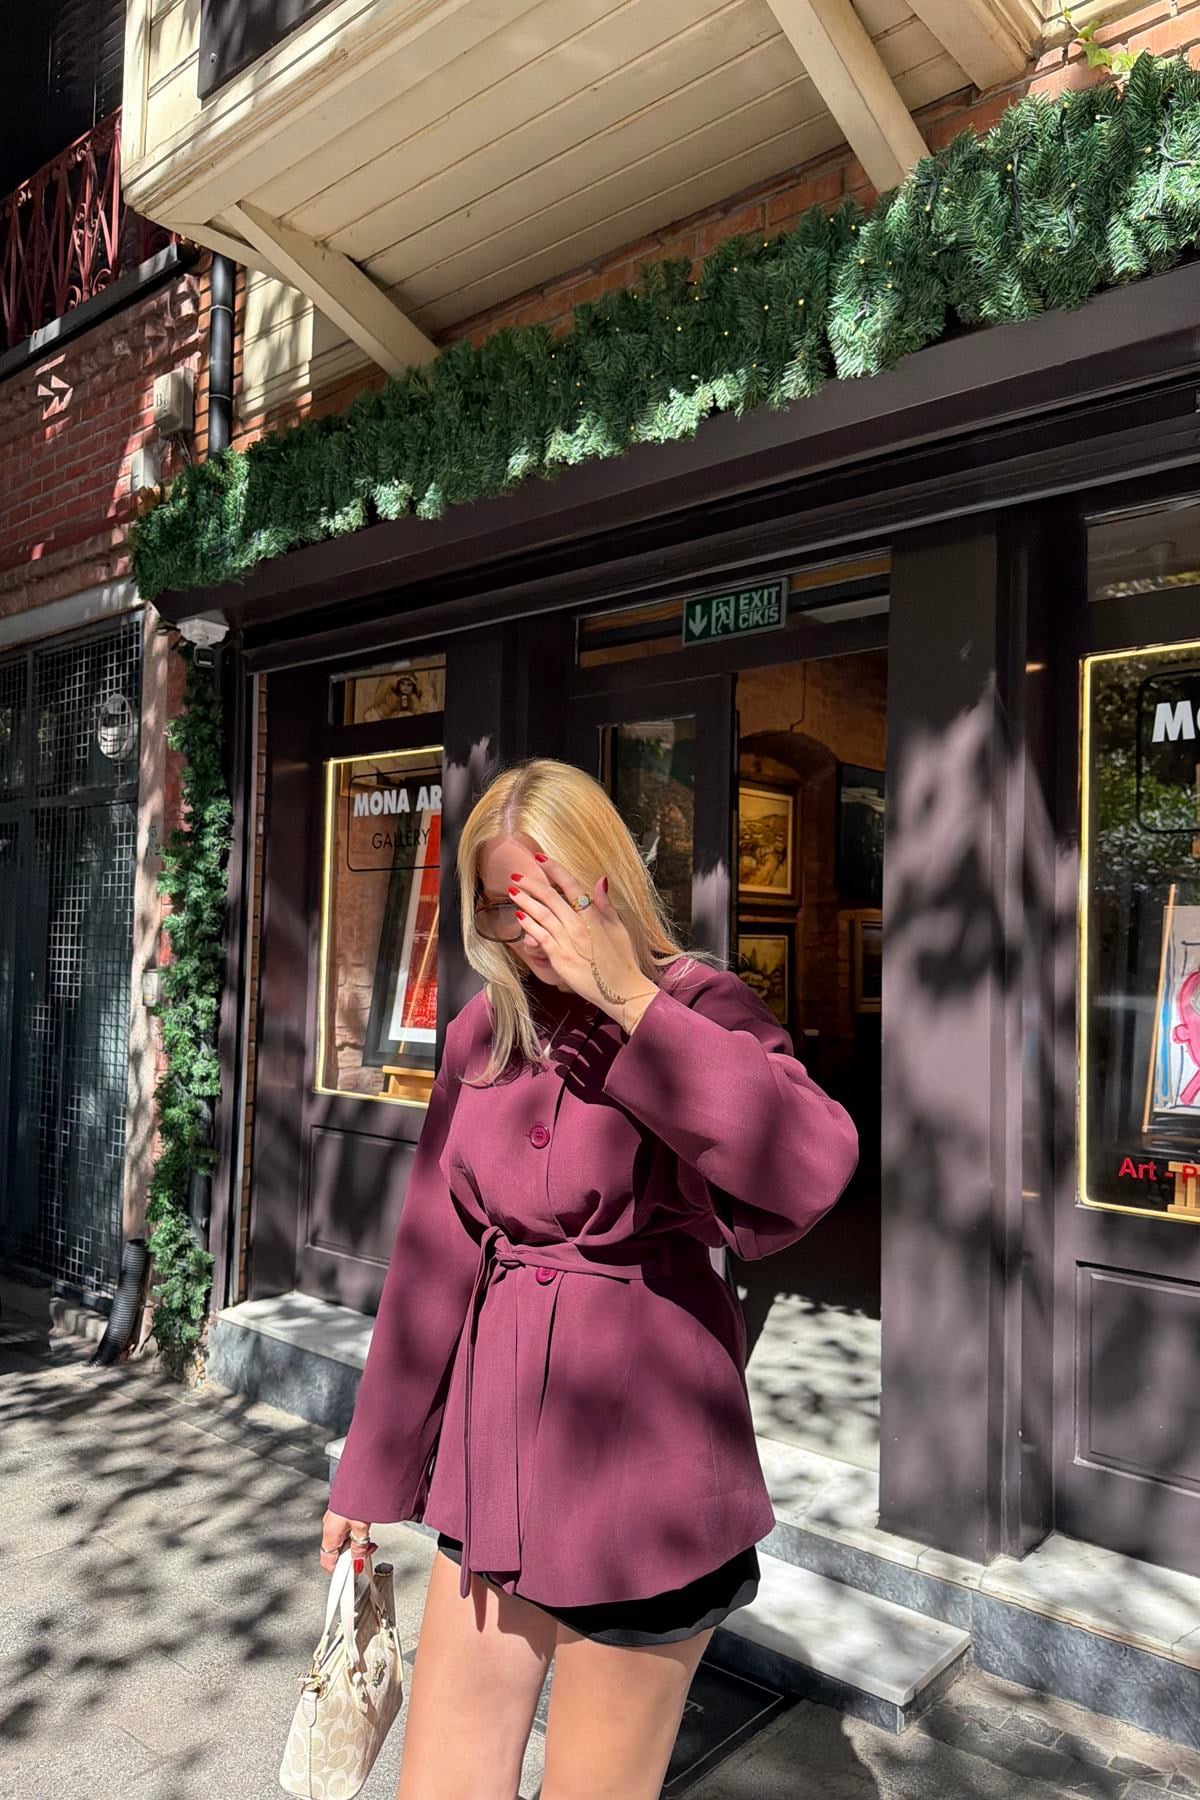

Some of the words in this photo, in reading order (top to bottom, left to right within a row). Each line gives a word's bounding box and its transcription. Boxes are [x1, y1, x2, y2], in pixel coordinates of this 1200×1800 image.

[739, 586, 780, 611] EXIT
[1151, 700, 1200, 742] M
[353, 788, 410, 818] MONA
[416, 784, 443, 812] AR
[371, 828, 431, 849] GALLERY
[1118, 1157, 1157, 1181] Art
